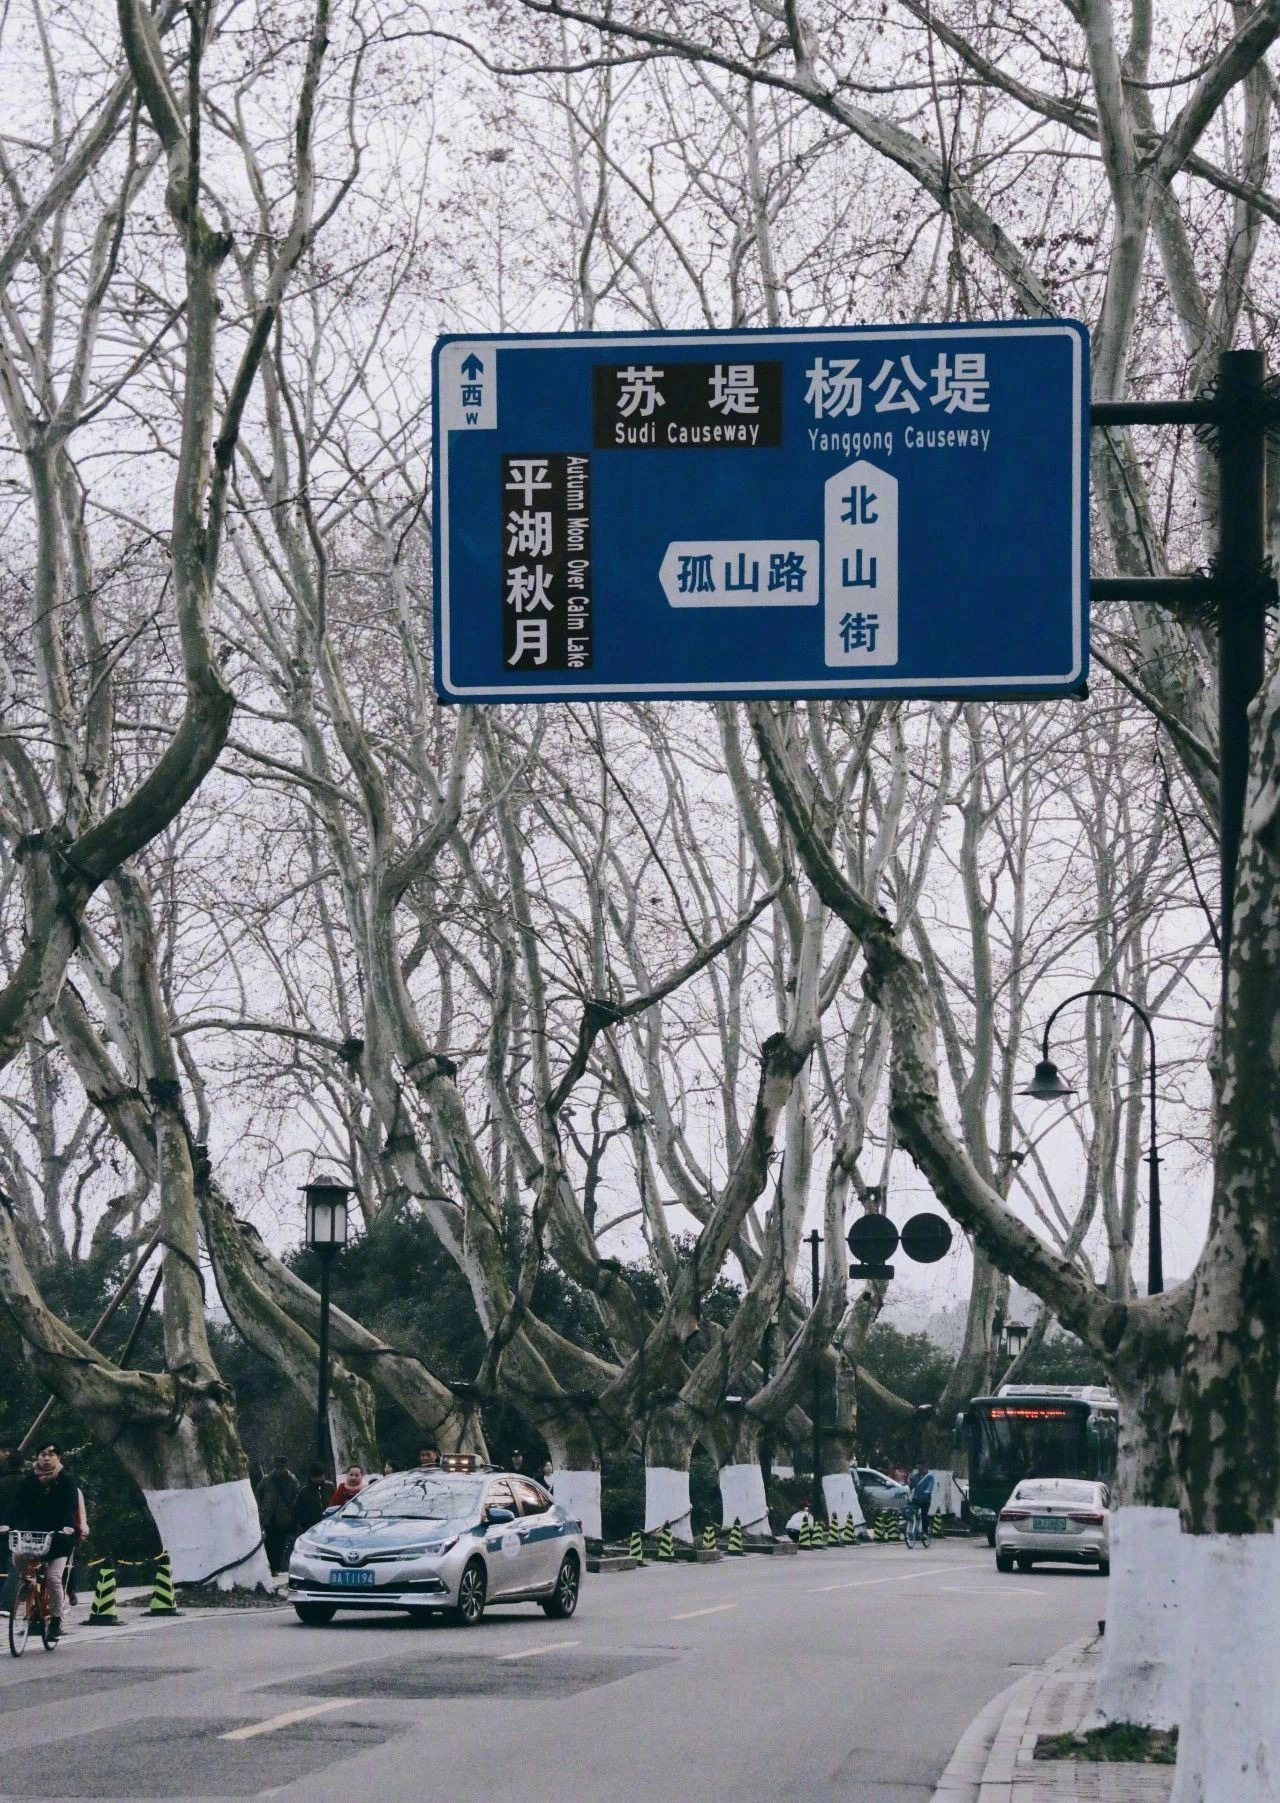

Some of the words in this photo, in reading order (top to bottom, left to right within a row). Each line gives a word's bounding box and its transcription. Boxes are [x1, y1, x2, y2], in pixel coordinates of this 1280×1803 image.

[461, 384, 483, 406] 西
[616, 365, 760, 417] 苏堤
[803, 352, 991, 418] 杨公堤
[465, 413, 478, 425] W
[615, 422, 656, 444] Sudi
[667, 422, 760, 446] Causeway
[808, 428, 893, 456] Yanggong
[904, 425, 991, 452] Causeway
[566, 456, 589, 511] Autumn
[567, 517, 590, 552] Moon
[505, 459, 554, 666] 平湖秋月
[567, 559, 590, 590] Over
[677, 551, 808, 593] 孤山路
[840, 485, 880, 654] 北山街
[567, 596, 590, 630] Calm
[567, 637, 590, 668] Lake
